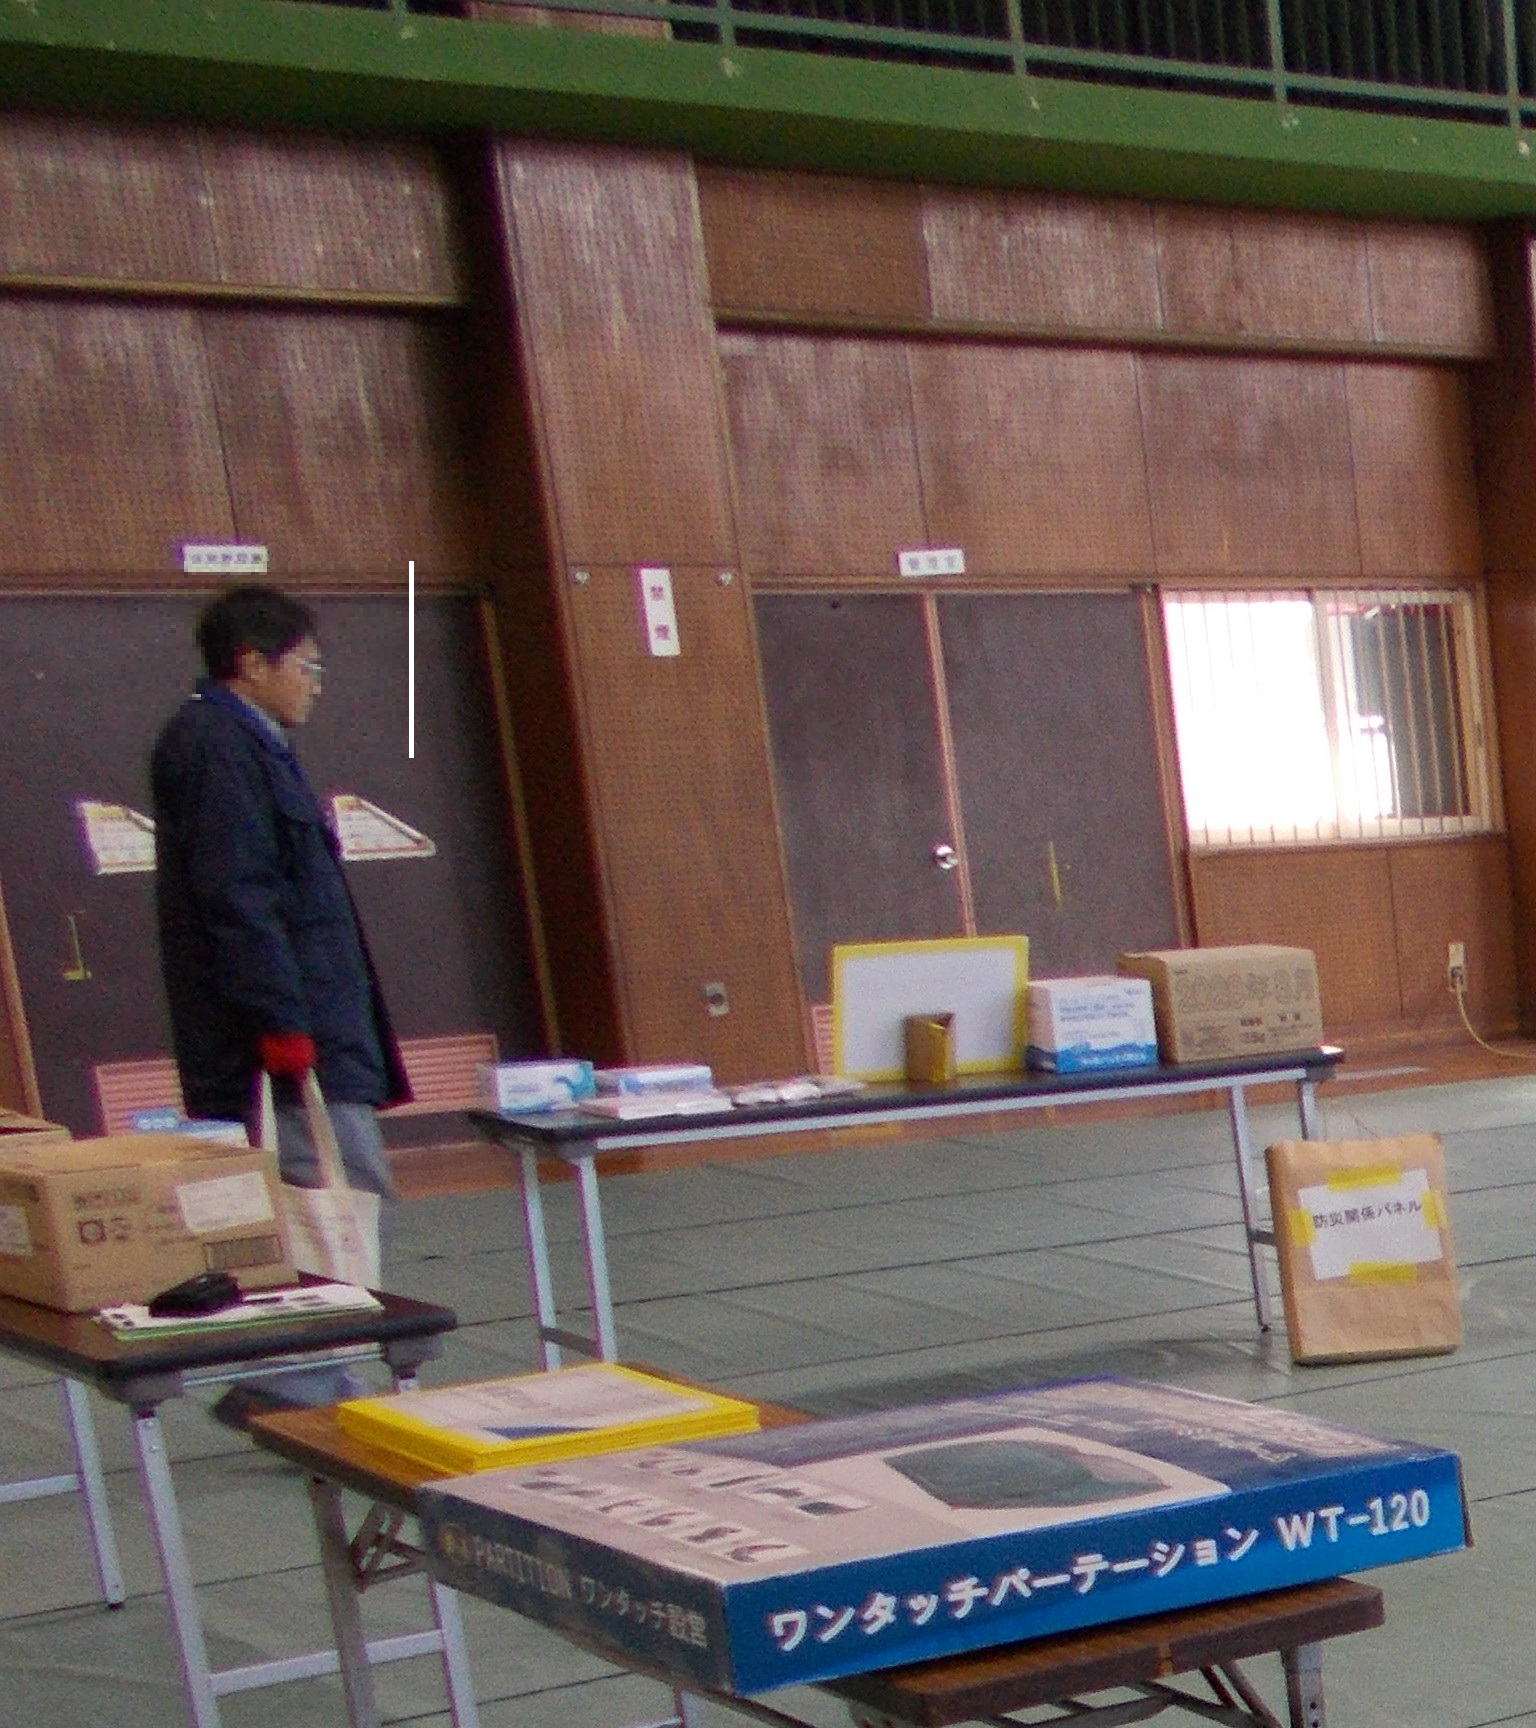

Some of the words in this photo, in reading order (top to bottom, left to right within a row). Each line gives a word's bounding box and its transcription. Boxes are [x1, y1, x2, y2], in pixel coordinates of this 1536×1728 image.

[1312, 1199, 1423, 1229] 防災関係パネル
[770, 1524, 1260, 1652] ワンタッチパーテーション
[1277, 1488, 1431, 1553] WT-120
